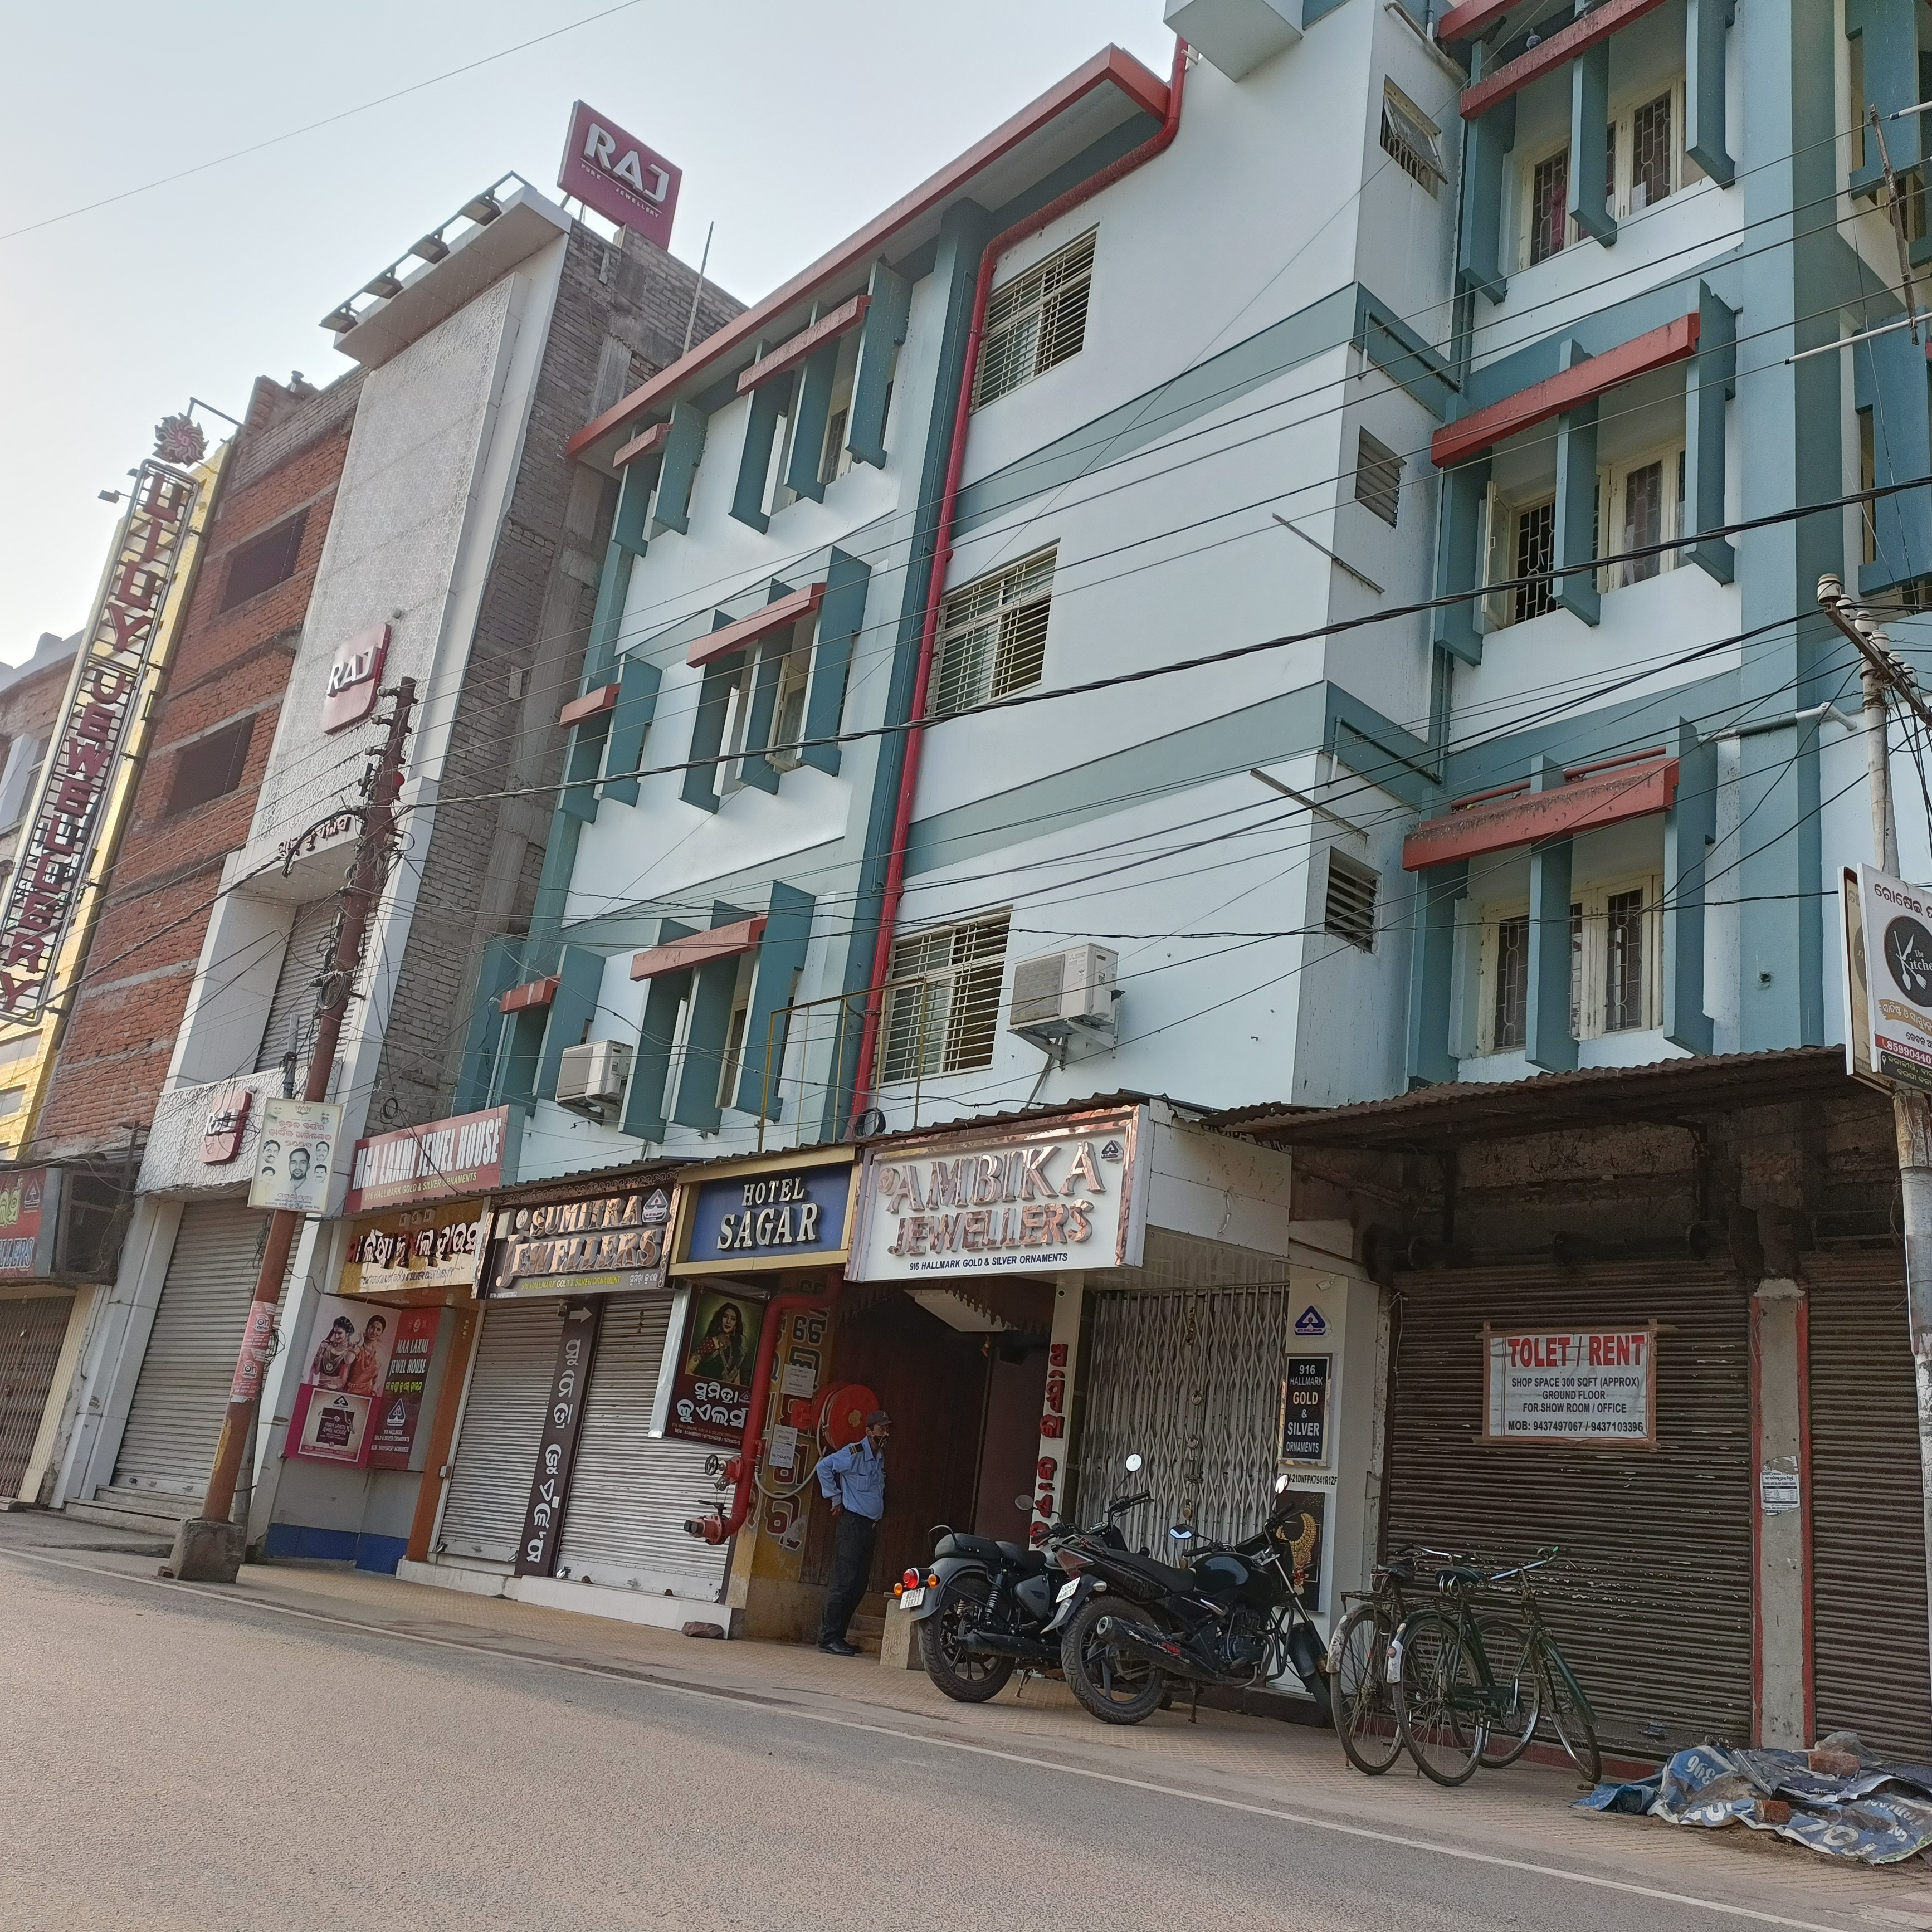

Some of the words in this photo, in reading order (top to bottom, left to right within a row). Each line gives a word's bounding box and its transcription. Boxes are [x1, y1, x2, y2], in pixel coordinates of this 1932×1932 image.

[584, 123, 669, 204] RAJ
[581, 163, 601, 180] PURE
[615, 188, 659, 218] JEWELLERY
[328, 645, 379, 696] RAJ
[0, 669, 127, 1011] JEWELLERY
[1914, 949, 1924, 958] The
[1887, 1041, 1932, 1065] 85990440
[352, 1145, 380, 1190] MAA
[379, 1136, 418, 1185] LAXMI
[416, 1128, 456, 1178] JEWEL
[455, 1118, 501, 1170] HOUSE
[364, 1192, 373, 1201] 916
[373, 1187, 402, 1200] HALLMARK
[402, 1185, 417, 1194] GOLD
[422, 1180, 441, 1190] SILVER
[442, 1172, 477, 1187] ORNAMENTS
[886, 1141, 1108, 1214] AMBIKA
[742, 1177, 804, 1206] HOTEL
[530, 1195, 642, 1237] SUMITRA
[716, 1203, 818, 1250] SAGAR
[887, 1199, 1095, 1257] JEWELLERS
[0, 1236, 35, 1269] LLERS
[496, 1229, 662, 1287] JEWELLERS
[909, 1261, 919, 1271] 916
[921, 1258, 961, 1270] HALLMARK
[963, 1257, 983, 1267] GOLD
[984, 1257, 989, 1266] &
[992, 1255, 1017, 1266] SILVER
[1019, 1252, 1068, 1264] ORNAMENTS
[529, 1280, 556, 1289] HALLMARK
[557, 1279, 570, 1287] GOLD
[575, 1277, 591, 1287] SILVER
[592, 1276, 622, 1285] ORNAMENT
[396, 1339, 409, 1353] MAA
[410, 1339, 429, 1353] LAXMI
[1508, 1337, 1570, 1367] TOLET
[1576, 1336, 1582, 1367] /
[1589, 1335, 1645, 1366] RENT
[388, 1359, 407, 1378] JEWEL
[407, 1359, 427, 1374] HOUSE
[1299, 1365, 1315, 1375] 916
[553, 1338, 581, 1430] ସୁମିତ୍ରା
[694, 1382, 739, 1404] ସୁମିତ୍ରା
[1290, 1377, 1323, 1386] HALLMARK
[1511, 1377, 1532, 1387] SHOP
[1534, 1377, 1560, 1387] SPACE
[1562, 1377, 1575, 1387] 300
[1577, 1377, 1598, 1388] SQFT
[1600, 1377, 1640, 1389] (APPROX)
[1292, 1392, 1318, 1406] GOLD
[1542, 1390, 1576, 1400] GROUND
[1578, 1390, 1606, 1399] FLOOR
[677, 1399, 749, 1428] ଜୁଏଲର୍ସ
[1301, 1409, 1307, 1418] &
[1523, 1403, 1539, 1412] FOR
[1540, 1403, 1564, 1412] SHOW
[1566, 1403, 1590, 1413] ROOM
[1592, 1403, 1595, 1413] /
[1597, 1403, 1627, 1413] OFFICE
[1287, 1422, 1320, 1436] SILVER
[1508, 1421, 1531, 1431] MOB:
[1533, 1421, 1582, 1432] 9437497067
[1585, 1421, 1588, 1432] /
[1591, 1421, 1643, 1432] 9437103396
[1286, 1441, 1319, 1453] ORNAMENTS
[1279, 1473, 1337, 1485] N-21DNFPK7941R1ZF
